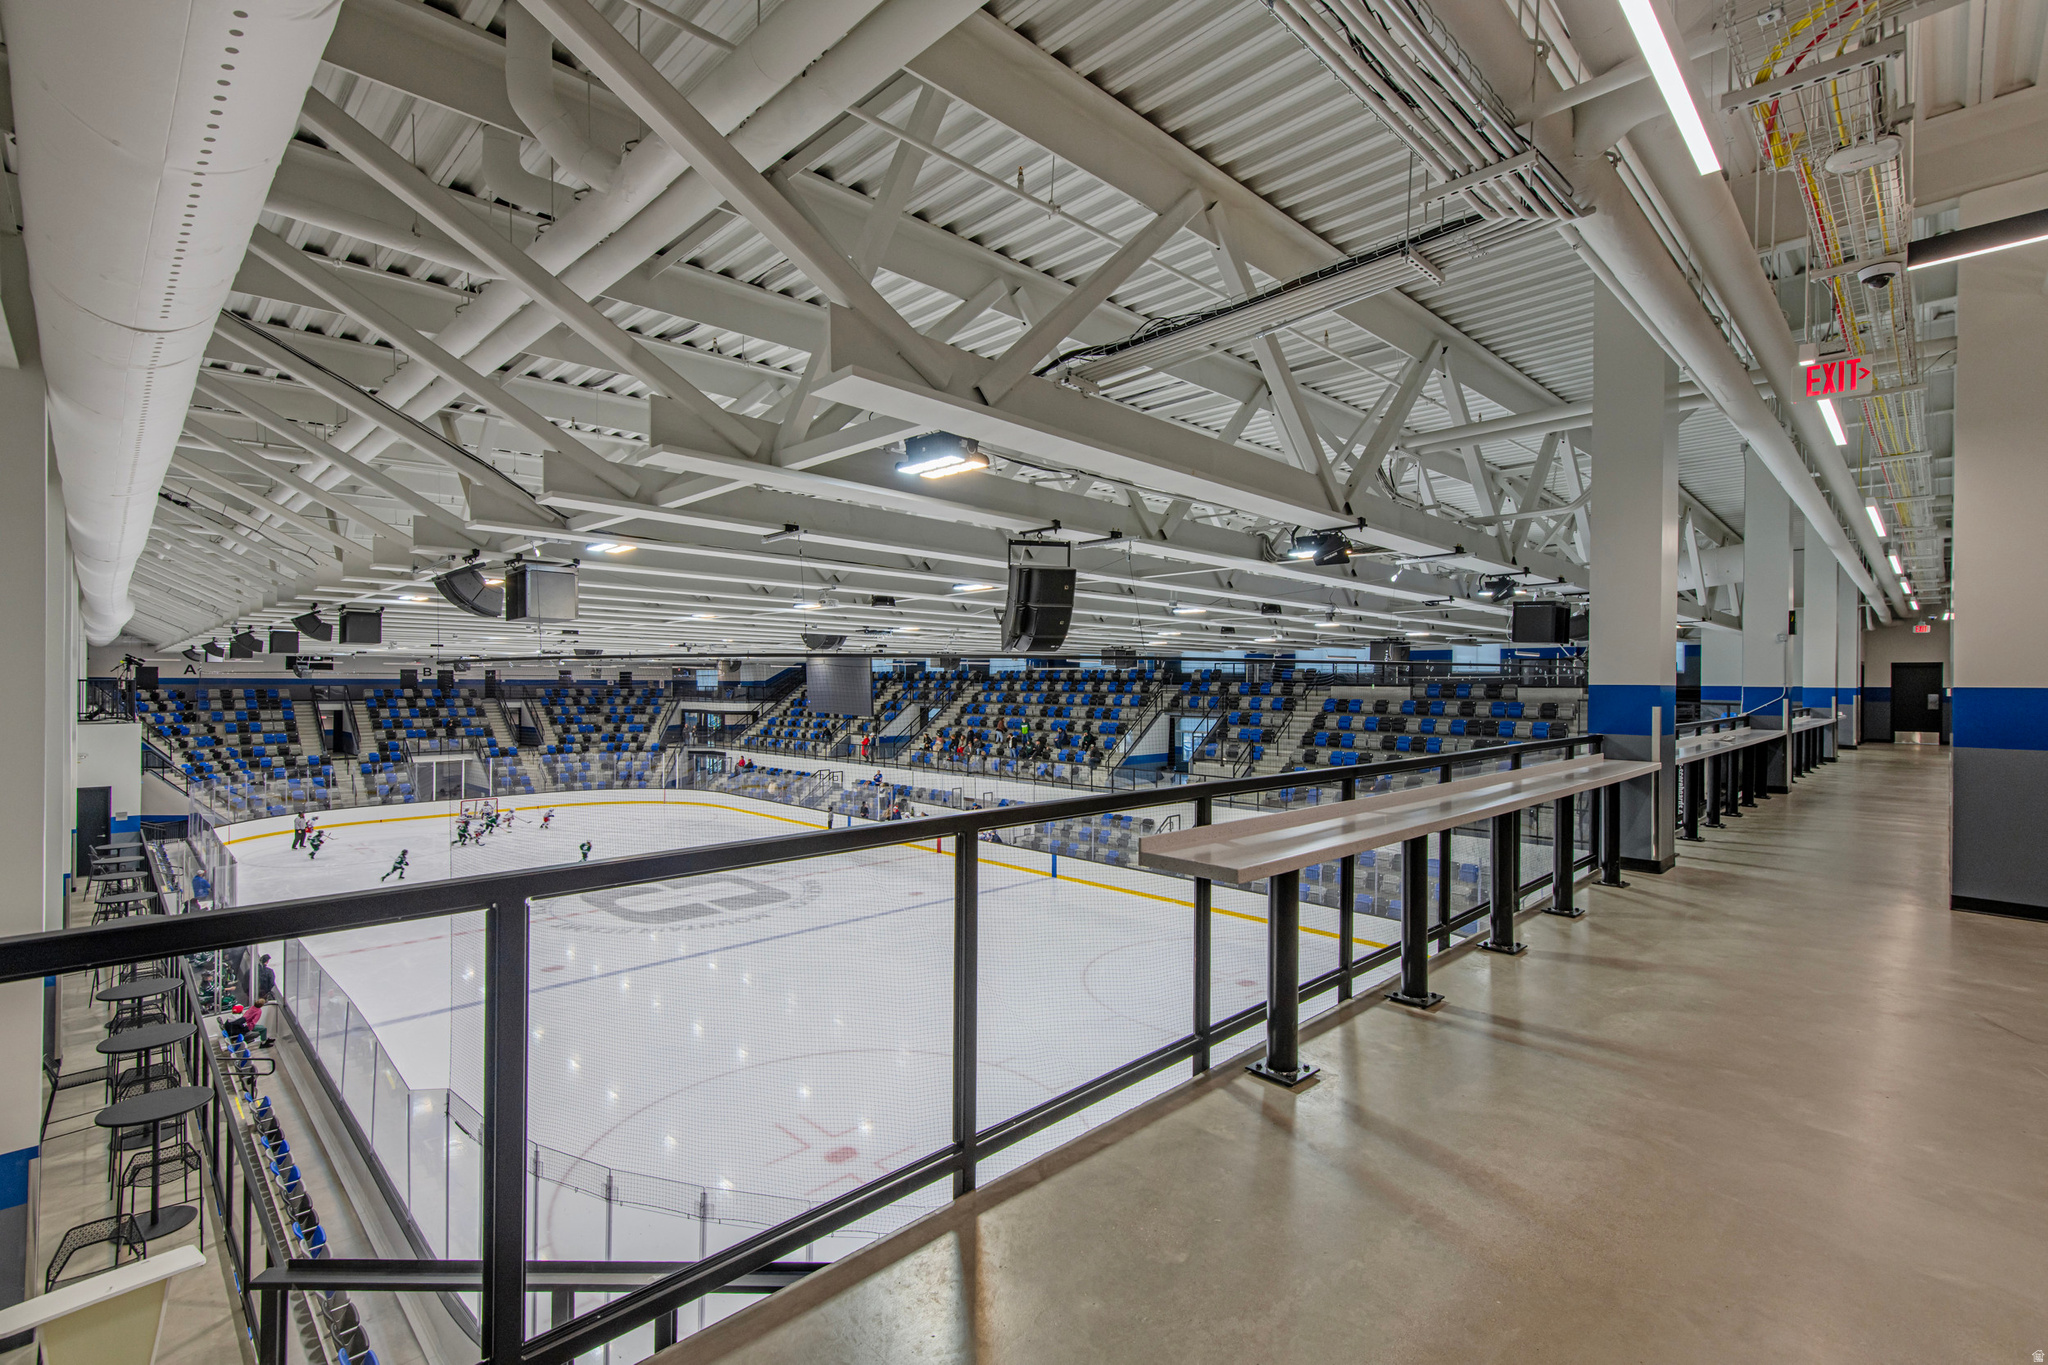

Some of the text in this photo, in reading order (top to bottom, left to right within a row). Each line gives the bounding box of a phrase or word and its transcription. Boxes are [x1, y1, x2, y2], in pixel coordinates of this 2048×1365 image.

[1806, 358, 1861, 397] EXIT
[183, 664, 196, 675] A
[423, 667, 432, 677] B
